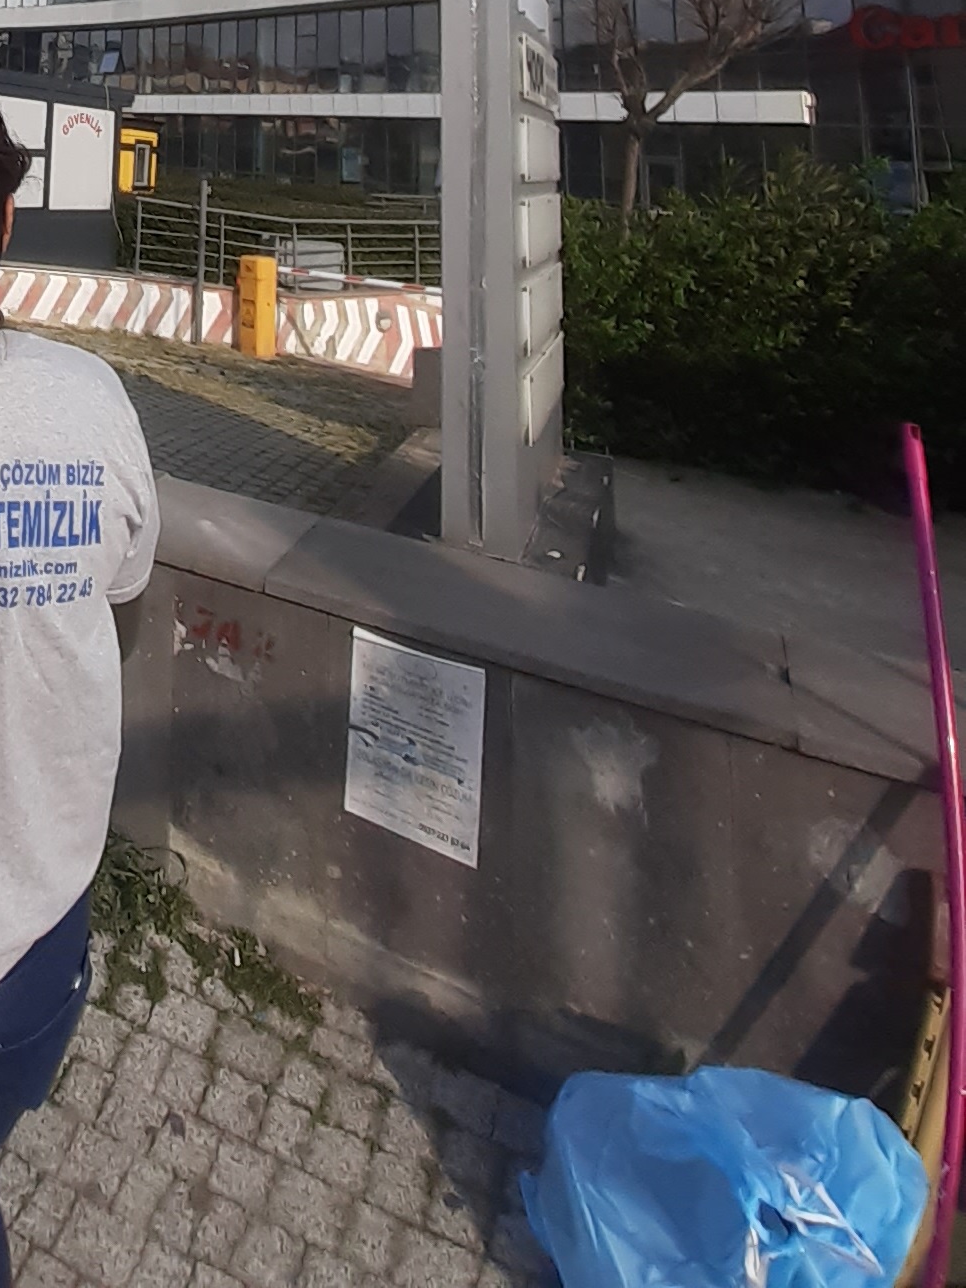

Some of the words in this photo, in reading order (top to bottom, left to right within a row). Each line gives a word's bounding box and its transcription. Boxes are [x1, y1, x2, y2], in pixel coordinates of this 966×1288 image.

[62, 112, 103, 138] GÜVENLİK
[0, 459, 61, 491] ÇÖZÜM
[66, 459, 105, 487] BİZİZ
[55, 581, 77, 603] 22
